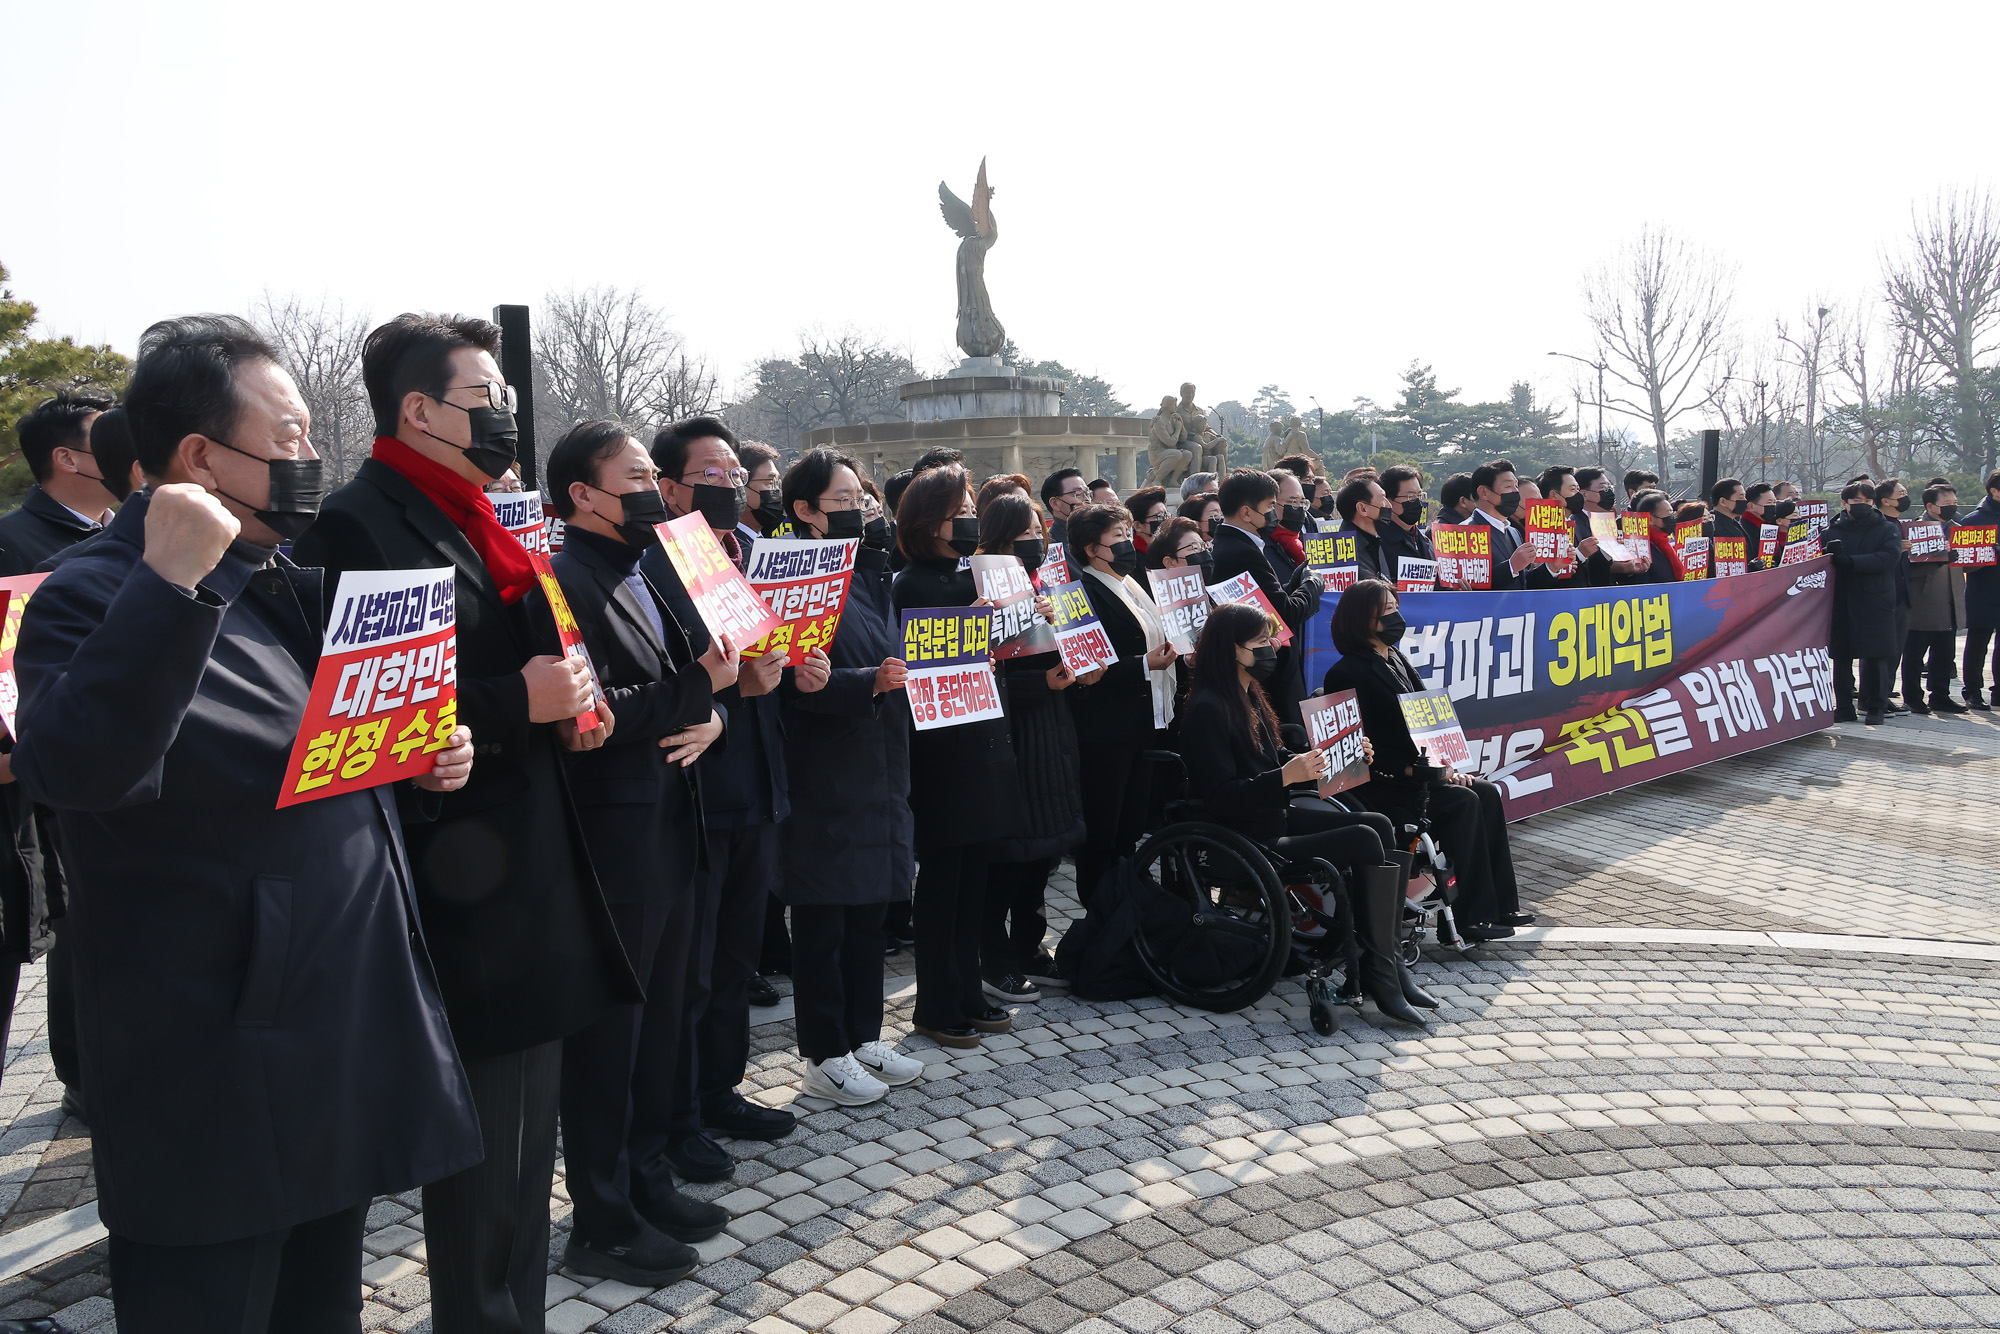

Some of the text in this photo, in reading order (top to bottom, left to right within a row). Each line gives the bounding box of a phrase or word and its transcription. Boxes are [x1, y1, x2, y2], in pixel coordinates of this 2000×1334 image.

[687, 524, 730, 577] 3법
[1336, 536, 1356, 562] 파괴
[1435, 530, 1488, 554] 사법파괴 3법
[1734, 542, 1745, 558] 3법
[1952, 529, 1996, 545] 사법파괴 3법
[751, 544, 844, 580] 사법파괴 악법
[1400, 564, 1434, 579] 사법파괴
[1459, 558, 1489, 583] 거부하라!
[331, 584, 429, 646] 사법파괴
[1061, 587, 1094, 621] 파괴
[904, 614, 990, 661] 삼권분립 파괴
[1399, 612, 1535, 703] 법파괴
[907, 671, 997, 722] 당장 중단하라!
[1431, 693, 1456, 723] 파괴
[1679, 659, 1768, 743] 위해
[292, 716, 392, 795] 헌정
